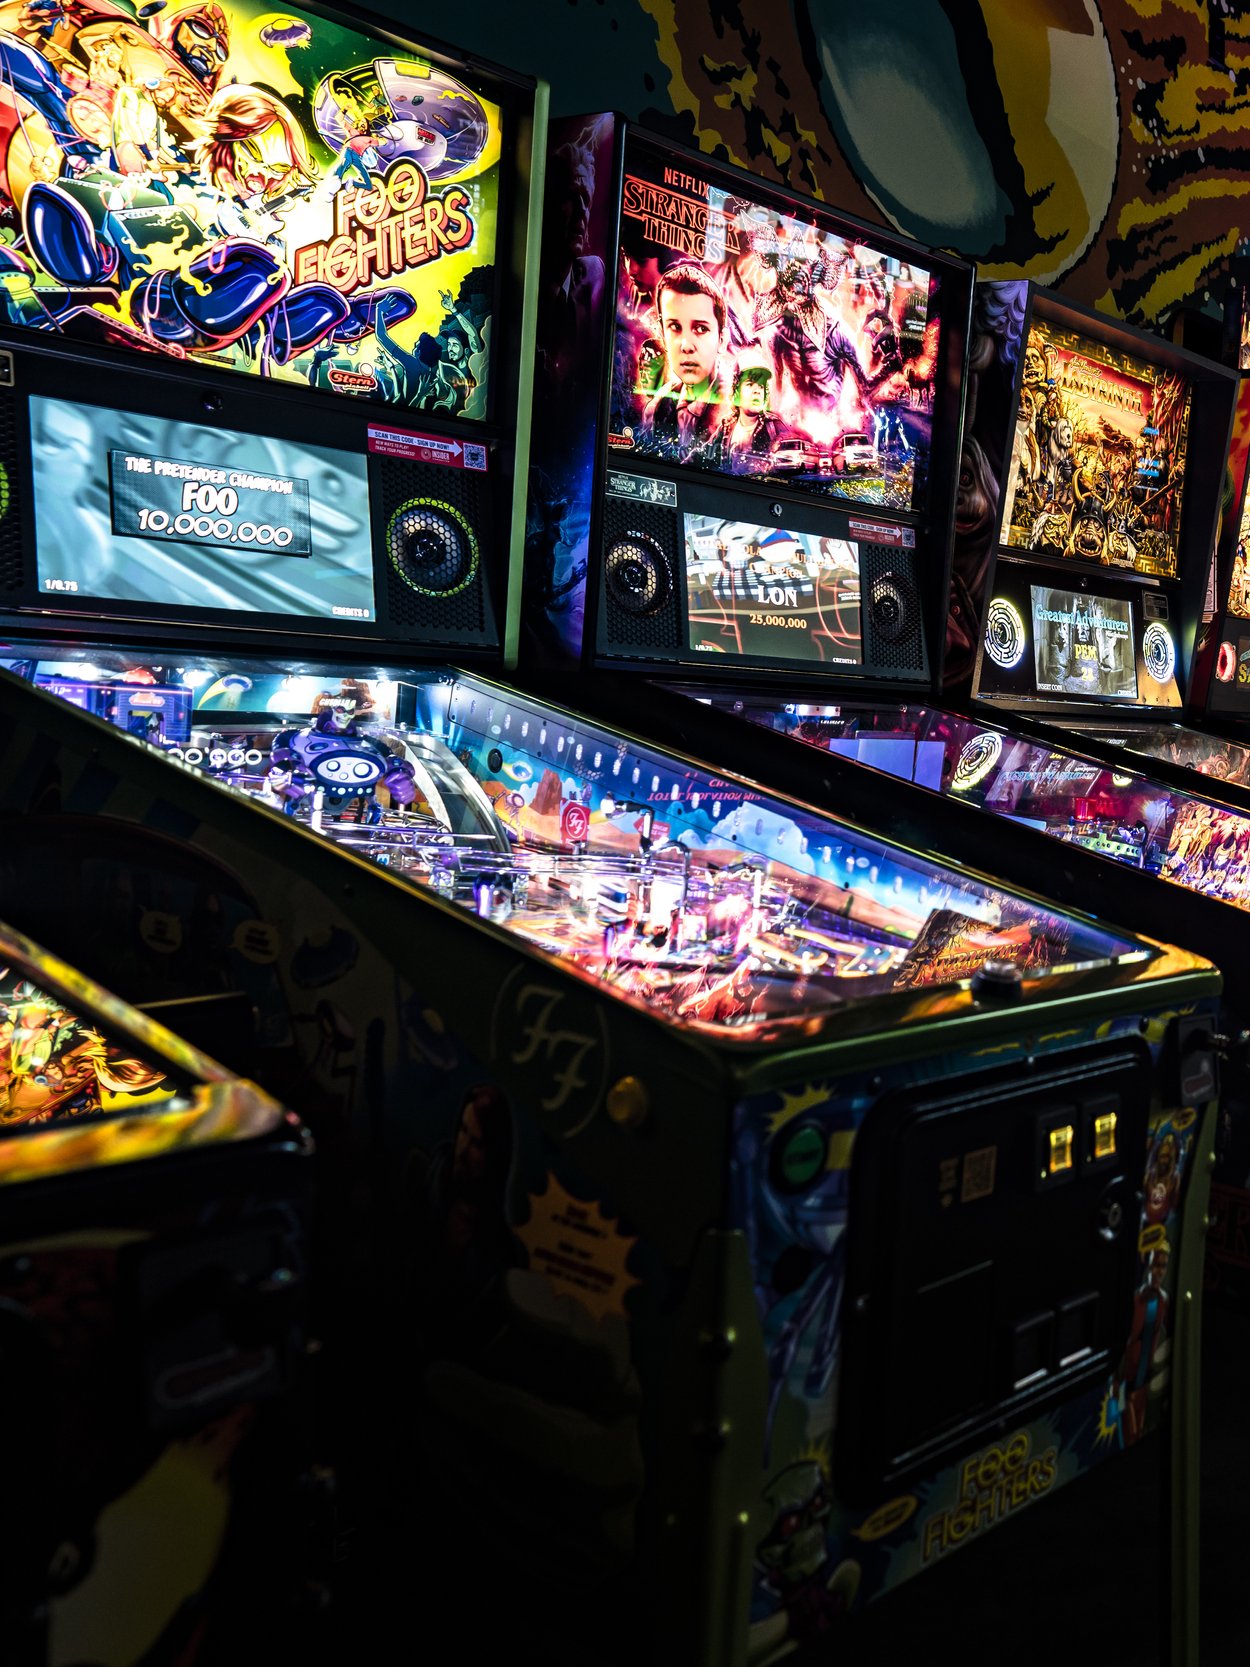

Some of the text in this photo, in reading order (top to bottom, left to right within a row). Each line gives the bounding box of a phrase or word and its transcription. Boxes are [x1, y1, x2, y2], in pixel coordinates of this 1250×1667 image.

[335, 161, 425, 236] FOO
[664, 166, 710, 201] NETFLIX
[623, 179, 741, 251] STRANGER
[296, 190, 474, 290] FIGHTERS
[642, 213, 726, 263] THINGS
[332, 373, 372, 386] Stern
[1060, 361, 1144, 417] LABYRINTH
[374, 431, 389, 440] SCAN
[389, 434, 401, 442] THIS
[401, 436, 414, 444] CODE
[416, 438, 429, 447] SIGN
[436, 442, 450, 451] NOW!
[431, 450, 450, 460] INSIDER
[125, 456, 293, 495] THE PRETENDER CHAMPION
[182, 481, 238, 516] FOO
[138, 508, 293, 547] 10,000,000
[758, 585, 798, 608] LON
[750, 613, 807, 630] 25,000,000
[1036, 604, 1128, 632] Greatest Adventurers
[1074, 644, 1098, 661] PEM
[961, 1432, 1030, 1502] FOO
[924, 1447, 1057, 1562] FIGHTERS
